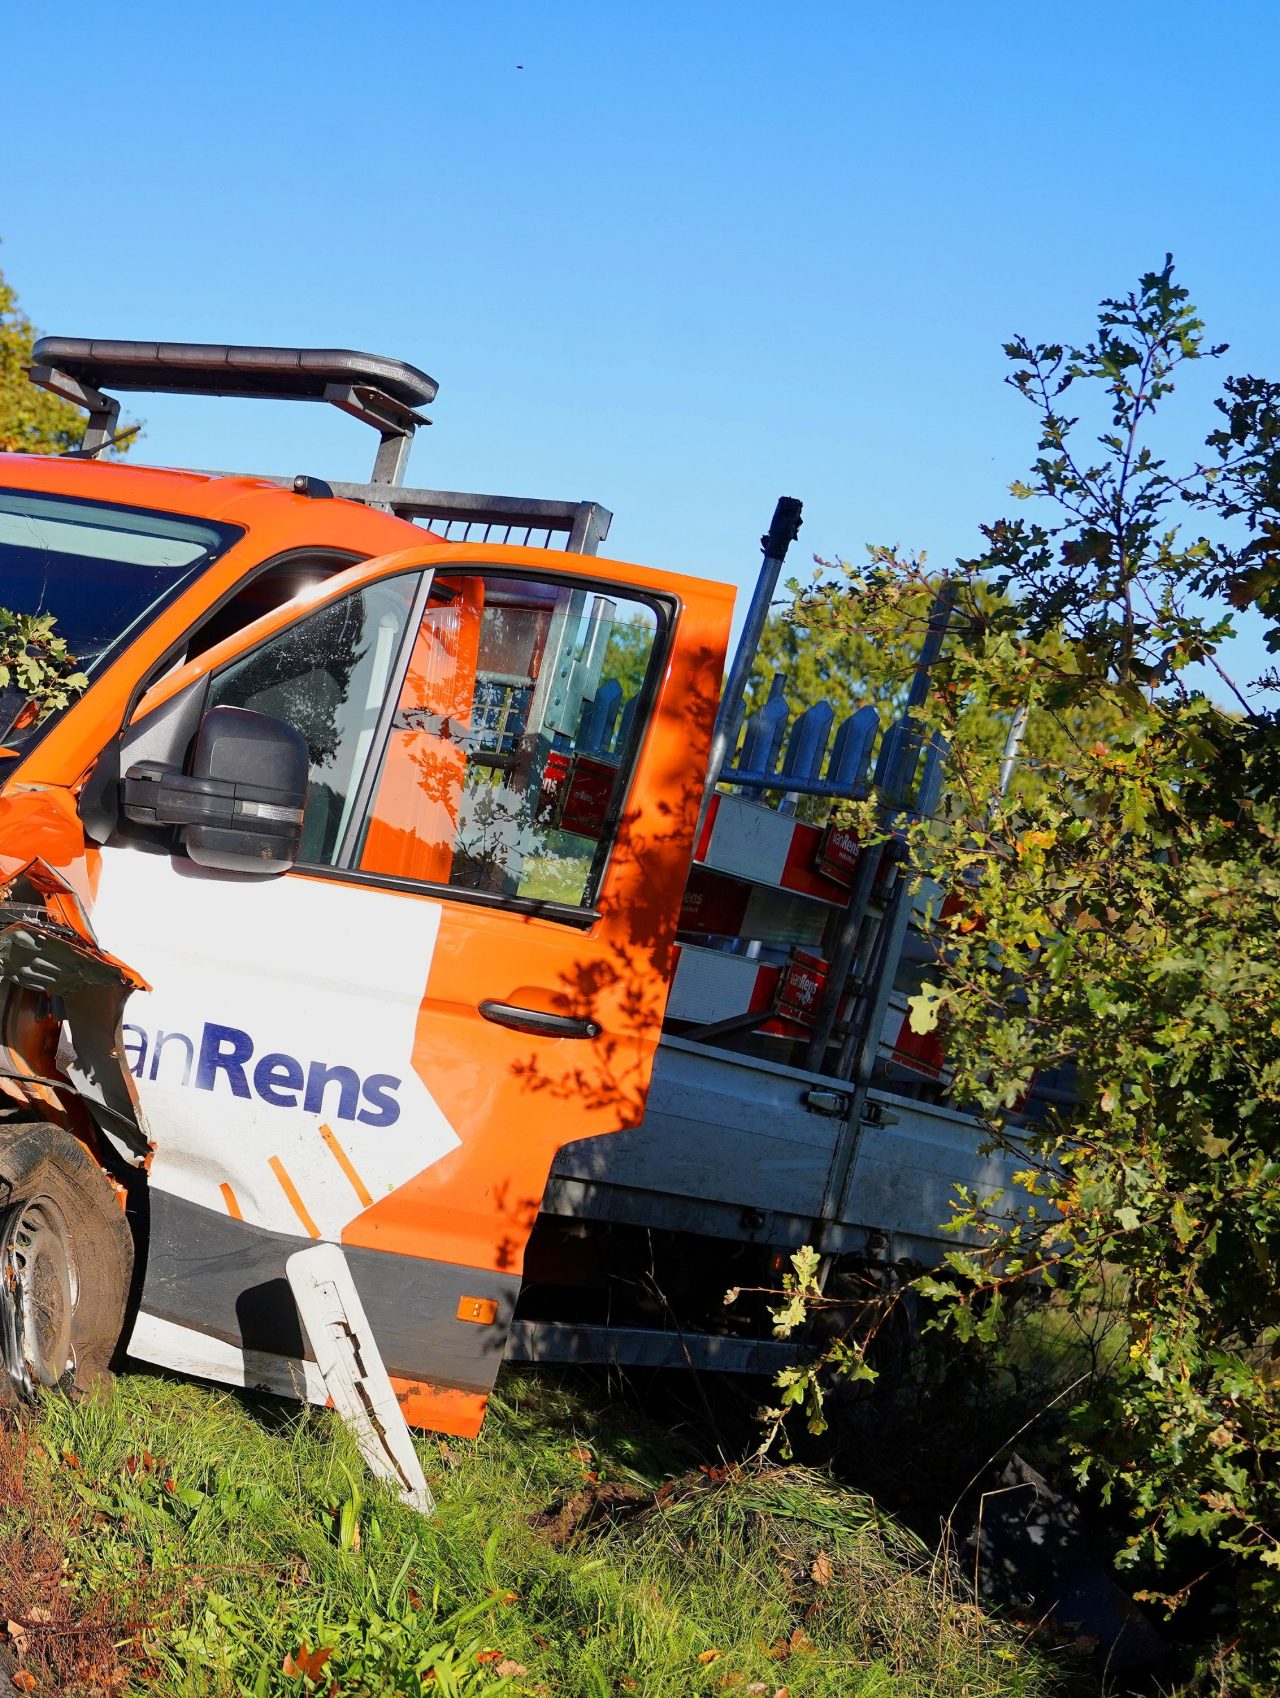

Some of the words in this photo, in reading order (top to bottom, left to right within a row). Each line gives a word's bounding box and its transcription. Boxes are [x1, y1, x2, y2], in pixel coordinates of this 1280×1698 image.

[832, 831, 861, 857] vanRens
[790, 973, 818, 994] vanRens
[122, 1021, 403, 1128] anRens
